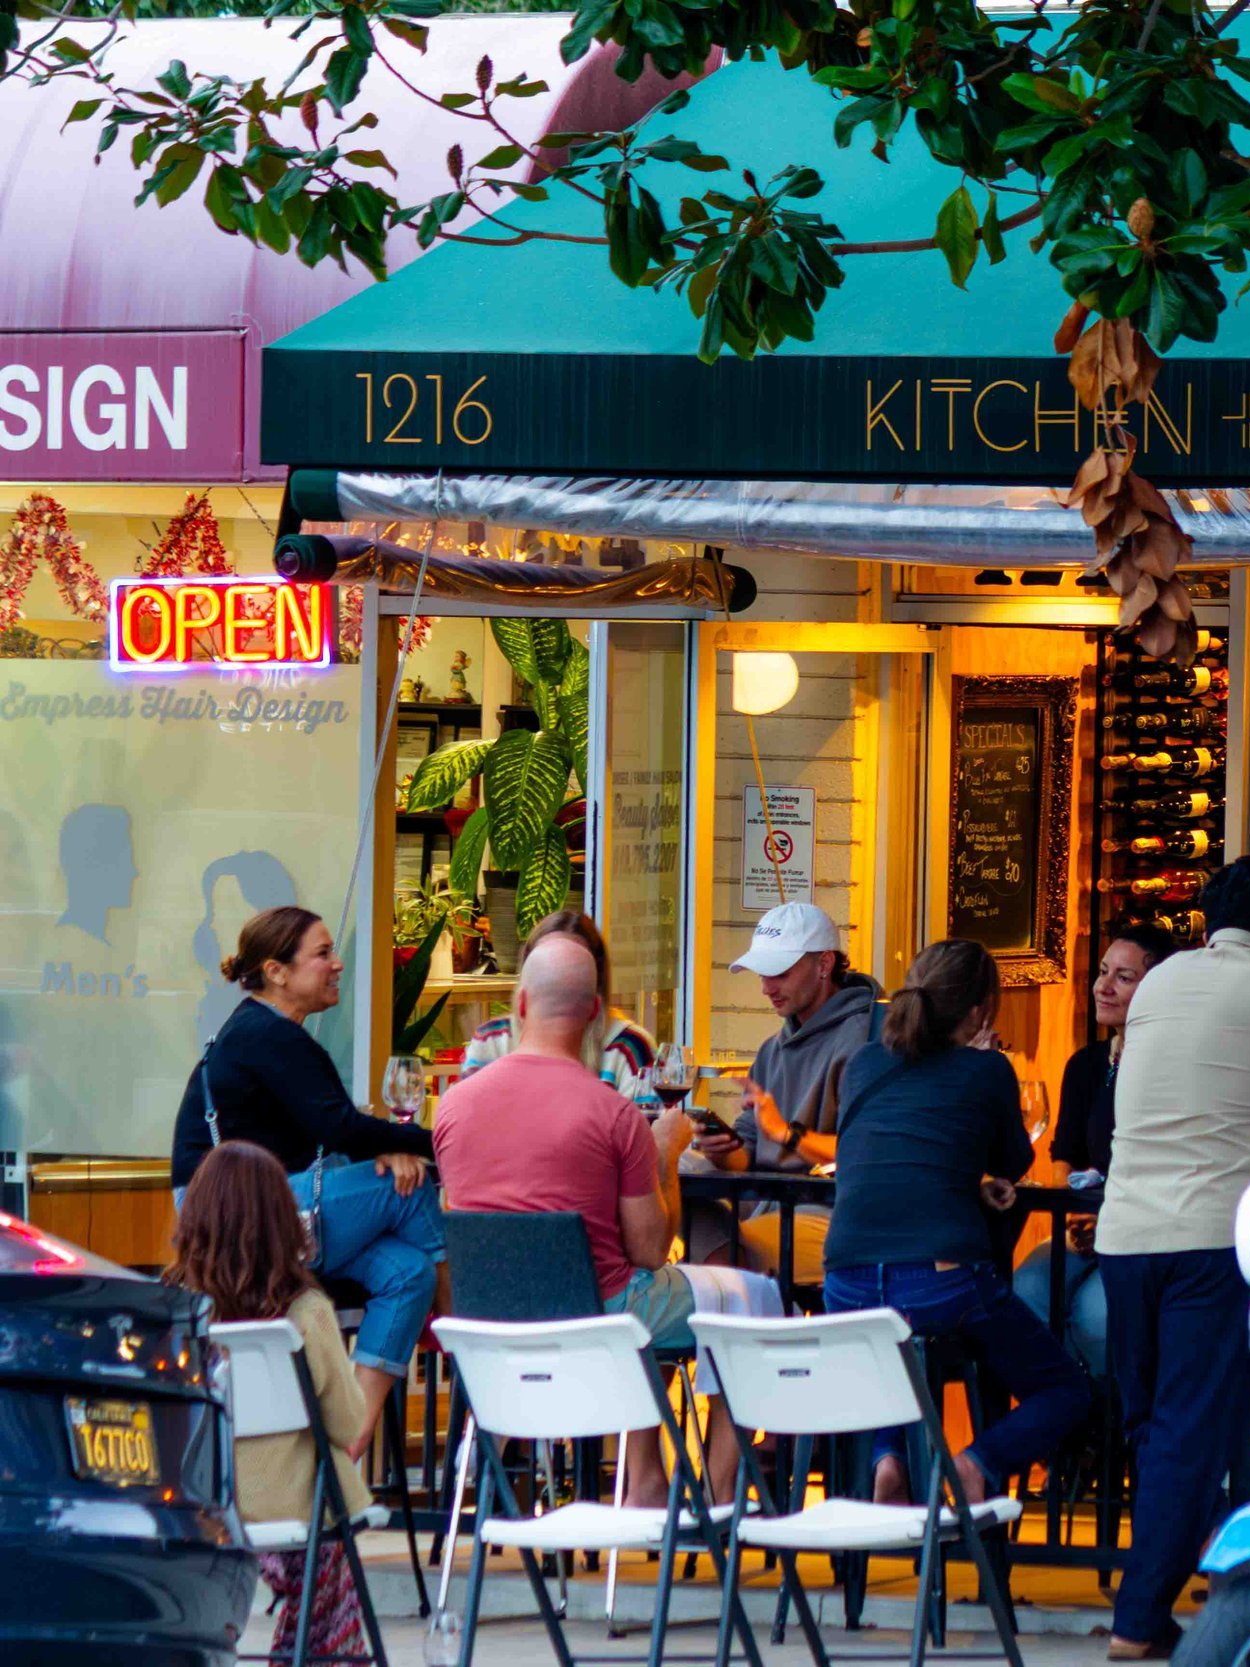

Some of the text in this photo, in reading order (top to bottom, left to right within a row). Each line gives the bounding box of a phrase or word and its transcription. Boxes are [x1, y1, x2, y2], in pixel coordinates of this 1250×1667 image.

[0, 363, 188, 451] SIGN
[355, 373, 492, 445] 1216
[866, 379, 1191, 456] KITCHEN
[122, 584, 321, 664] OPEN
[0, 680, 349, 735] Empress Hair Design
[964, 723, 1026, 749] SPECIALS
[771, 794, 800, 805] Smoking
[40, 960, 149, 999] Men's
